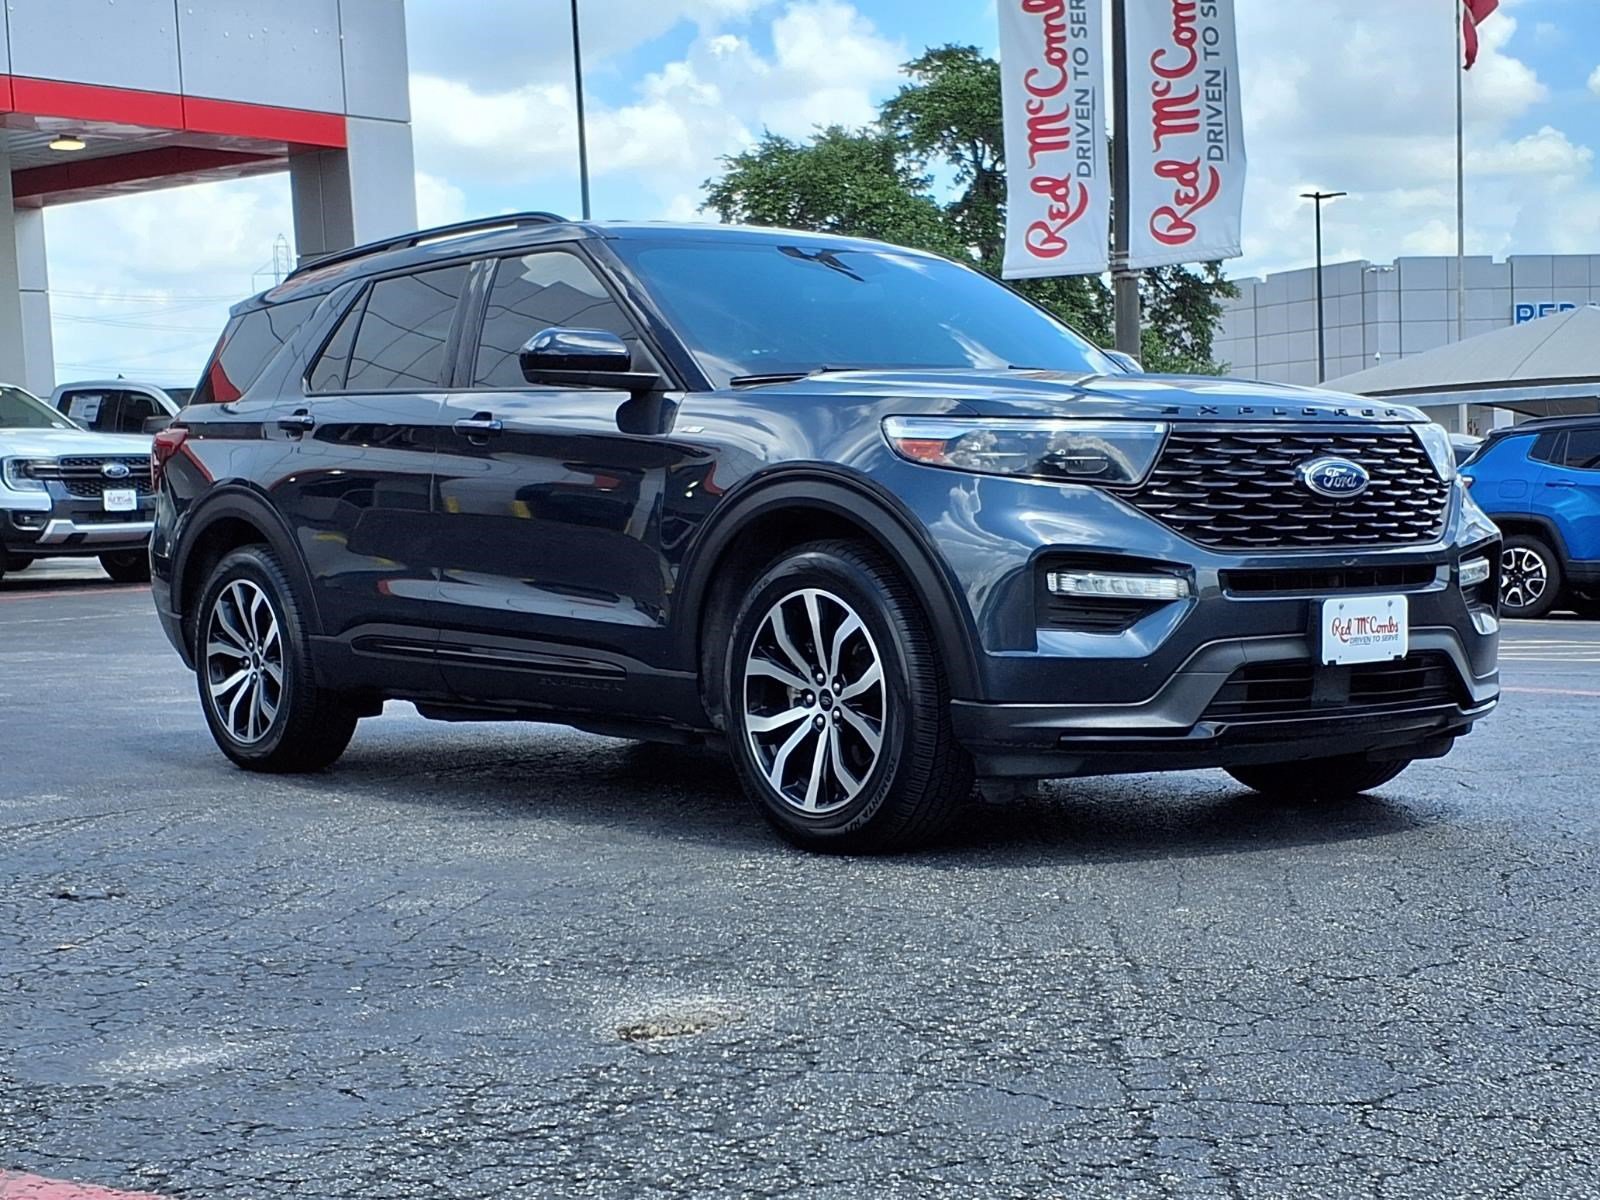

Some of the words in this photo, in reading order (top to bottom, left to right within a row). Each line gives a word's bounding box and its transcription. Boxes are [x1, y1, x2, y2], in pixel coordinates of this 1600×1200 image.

[1200, 0, 1218, 18] S
[1202, 27, 1220, 62] TO
[1072, 46, 1090, 81] TO
[1073, 89, 1092, 178] DRIVEN
[1203, 70, 1225, 162] DRIVEN
[1025, 172, 1089, 259] Red
[1150, 156, 1220, 246] Red
[1323, 467, 1357, 488] Ford
[1332, 617, 1353, 643] Red
[1354, 615, 1399, 636] McCombs
[1349, 636, 1371, 645] DRIVEN
[1372, 635, 1380, 643] TO
[1382, 633, 1399, 642] SERVE
